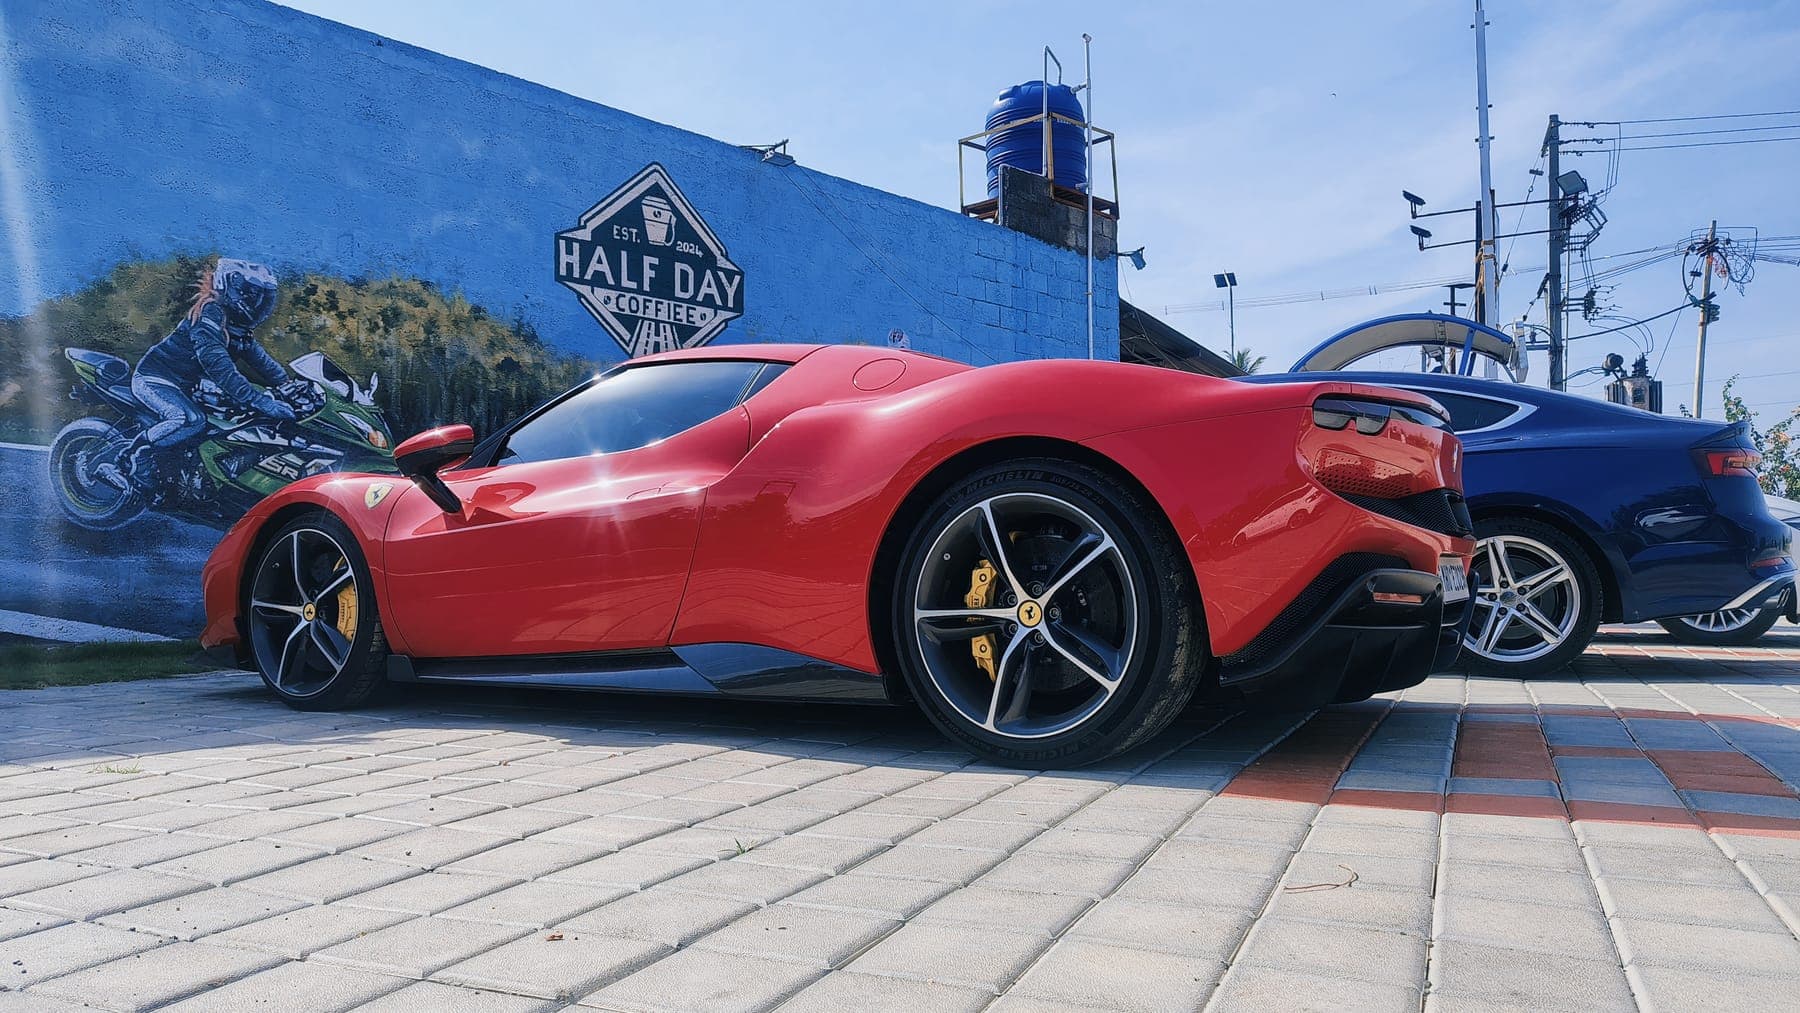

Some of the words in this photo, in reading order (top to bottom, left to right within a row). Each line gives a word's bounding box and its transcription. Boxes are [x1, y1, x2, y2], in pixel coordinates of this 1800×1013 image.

[613, 224, 641, 243] EST.
[675, 240, 704, 258] 2024
[558, 238, 660, 292] HALF
[674, 261, 742, 309] DAY
[615, 293, 697, 325] COFFIEE
[966, 470, 1044, 493] MICHELIN
